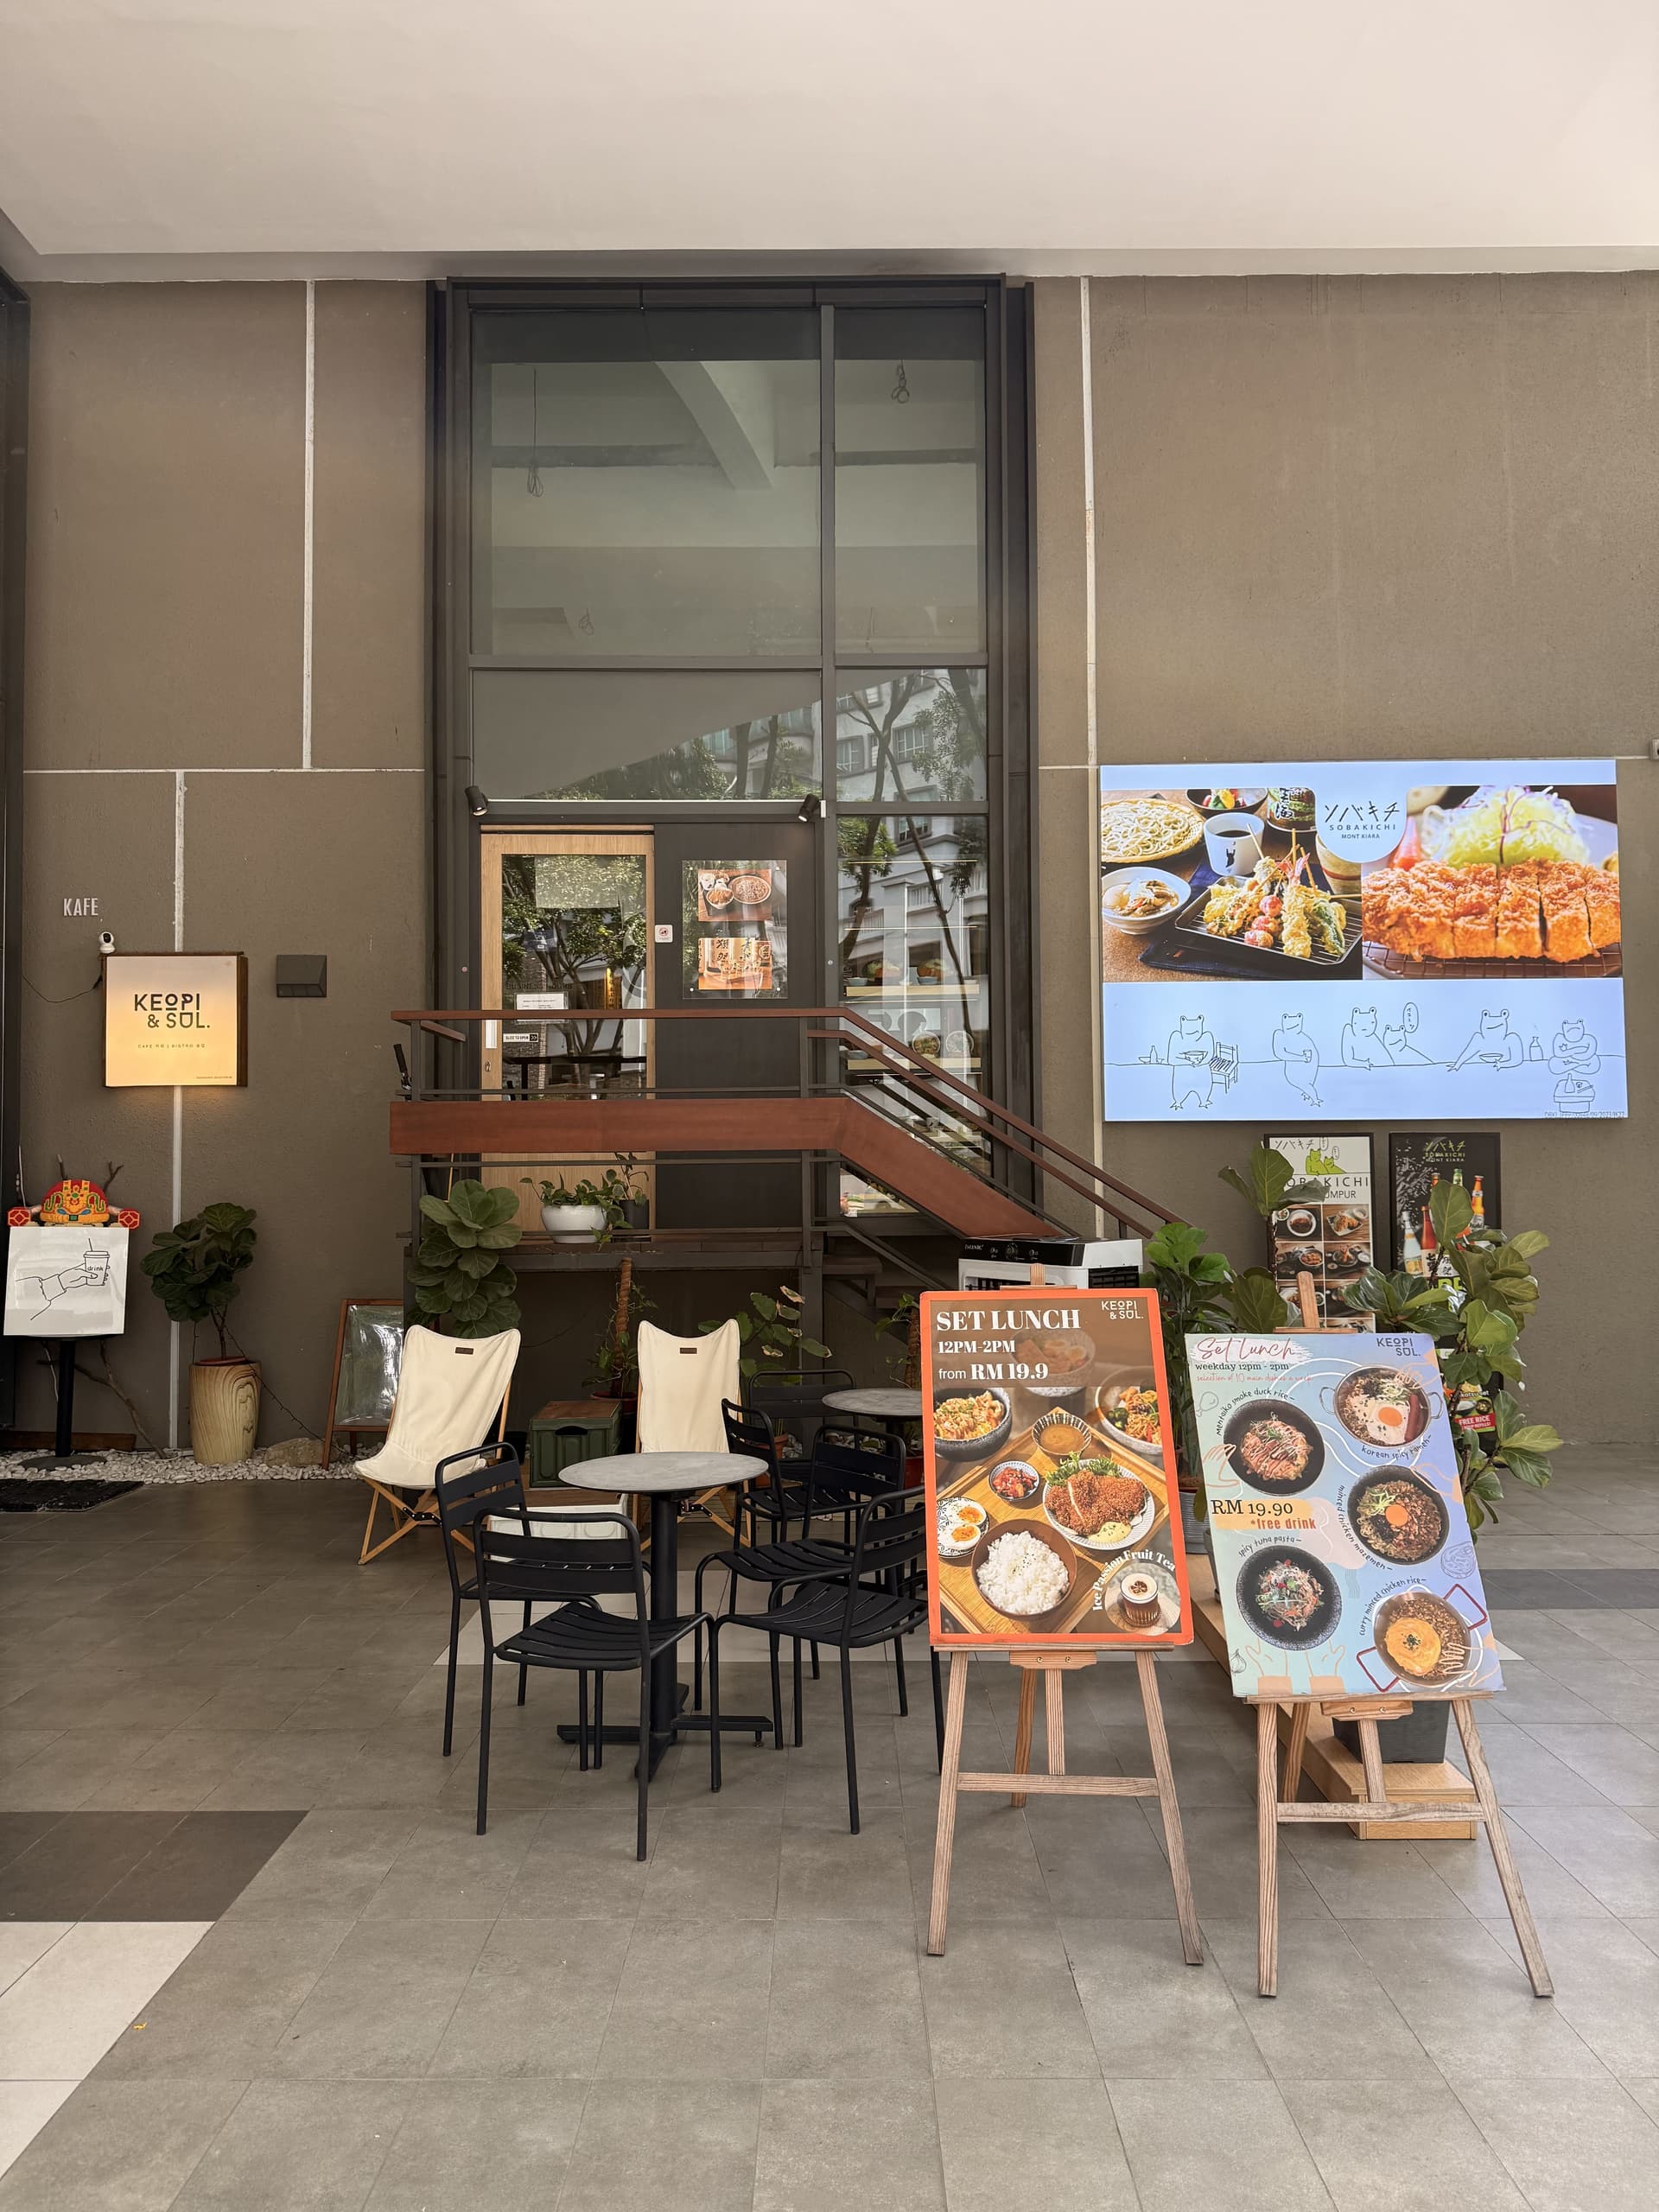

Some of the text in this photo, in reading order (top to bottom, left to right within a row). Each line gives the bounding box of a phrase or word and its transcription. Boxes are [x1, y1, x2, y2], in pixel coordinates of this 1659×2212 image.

[1325, 800, 1400, 823] ソバキチ
[63, 898, 99, 916] KAFE
[134, 994, 200, 1011] KEOPI
[147, 1014, 160, 1028] &
[1102, 1300, 1137, 1311] KEOPI
[936, 1309, 1081, 1331] SET LUNCH
[938, 1339, 1015, 1354] 12PM-2PM
[1197, 1337, 1241, 1363] Set
[1376, 1338, 1413, 1347] KEOPI
[938, 1363, 1049, 1380] from RM 19.9
[1195, 1363, 1236, 1371] weekday
[1236, 1373, 1244, 1382] 10
[1233, 1391, 1253, 1405] smoke
[1254, 1387, 1272, 1395] duck
[1459, 1417, 1474, 1426] FREE
[1362, 1445, 1389, 1459] korean
[1391, 1449, 1409, 1460] spicy
[1337, 1485, 1346, 1512] minced
[1211, 1500, 1294, 1516] RM 19.90
[1286, 1518, 1317, 1529] drink
[1338, 1514, 1355, 1542] chicken
[1238, 1544, 1254, 1557] spicy
[1255, 1536, 1272, 1547] tuna
[1092, 1548, 1175, 1611] Ice Passion Fruit Tea
[1381, 1580, 1406, 1595] chicken
[1365, 1591, 1382, 1615] minced
[1359, 1616, 1372, 1636] curry
